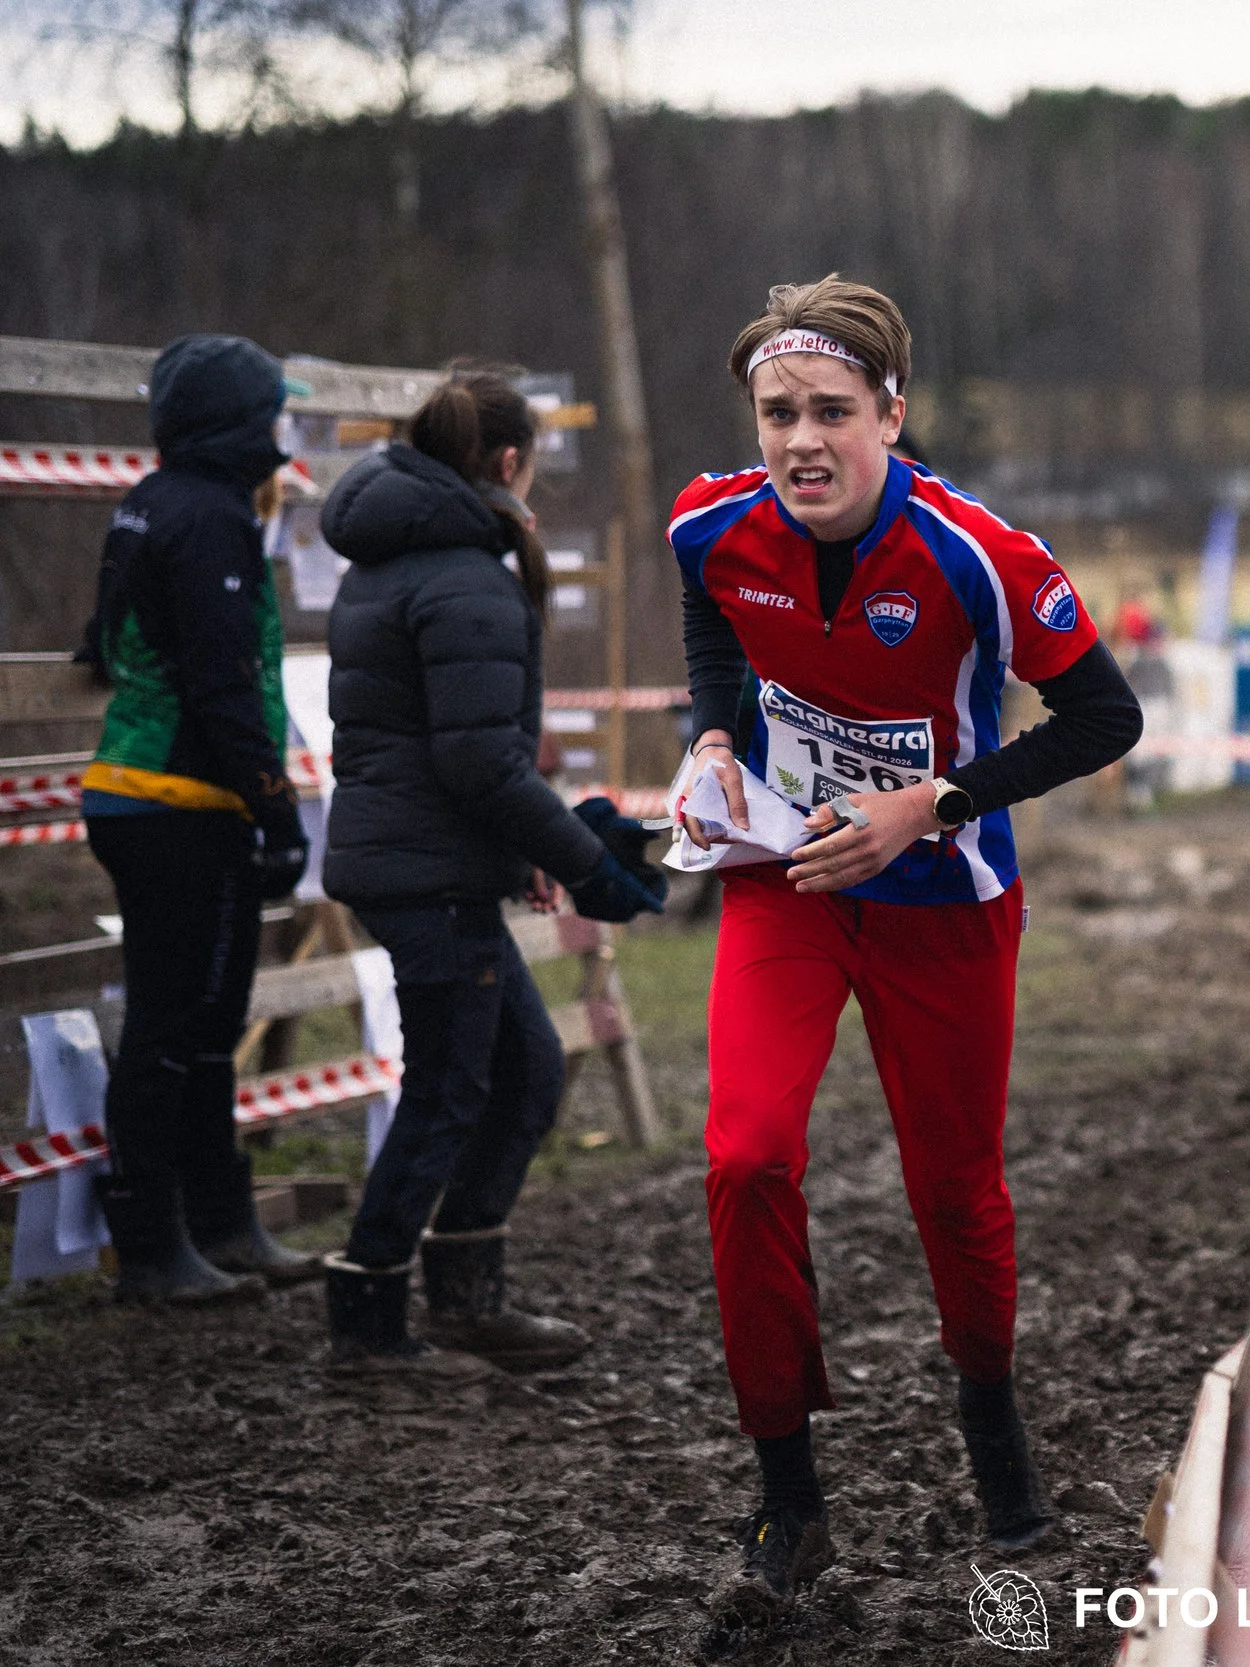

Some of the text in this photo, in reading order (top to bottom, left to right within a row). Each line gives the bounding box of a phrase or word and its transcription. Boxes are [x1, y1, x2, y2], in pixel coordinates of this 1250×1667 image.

[738, 586, 796, 610] TRIMTEX
[765, 687, 928, 750] bagheera
[861, 748, 876, 758] STL
[877, 754, 888, 762] #1
[890, 757, 912, 766] 2026
